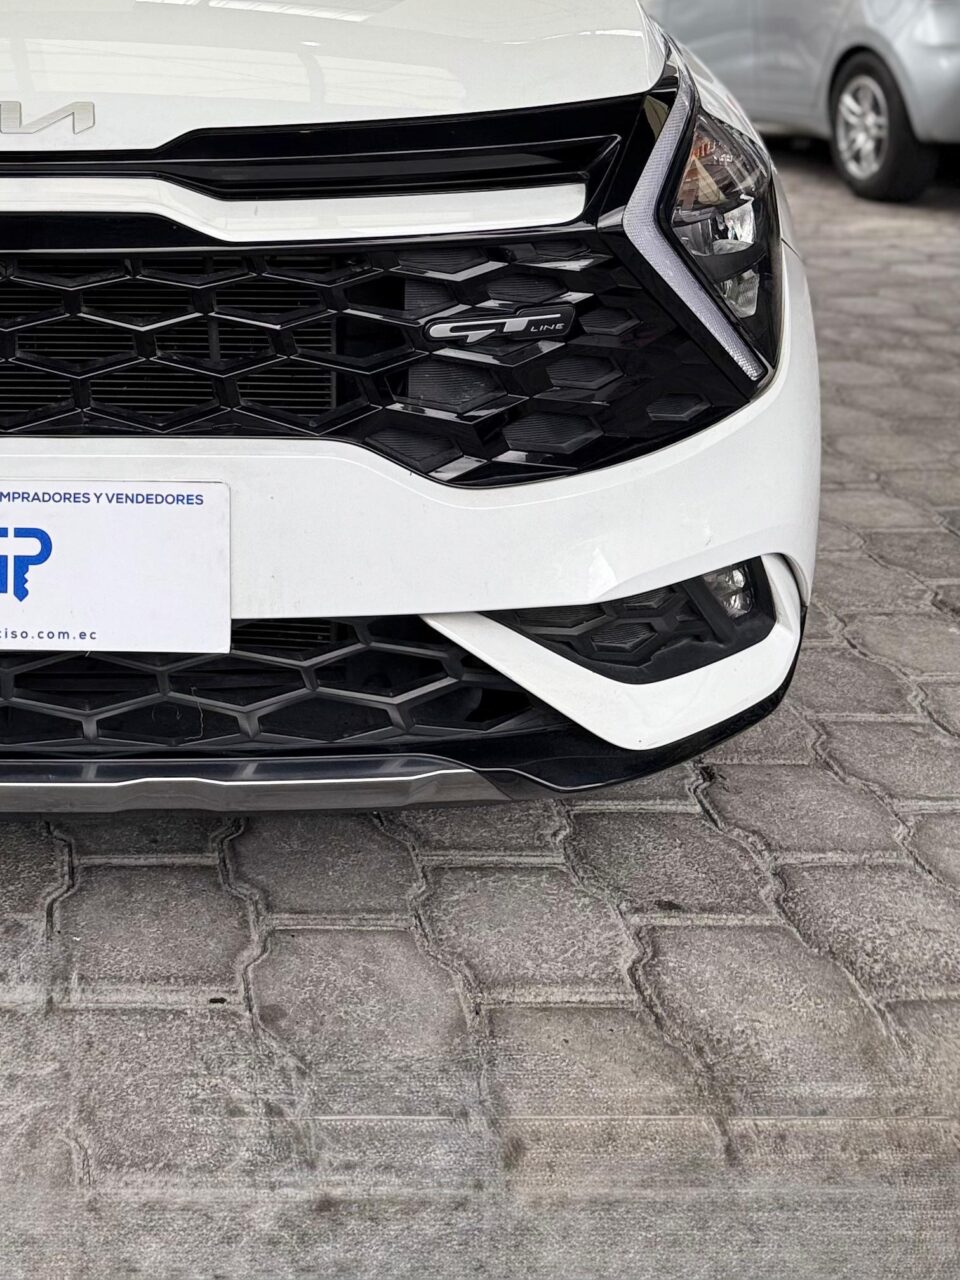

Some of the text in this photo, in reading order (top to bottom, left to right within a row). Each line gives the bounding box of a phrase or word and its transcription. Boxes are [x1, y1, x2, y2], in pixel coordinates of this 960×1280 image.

[530, 322, 565, 332] LINE
[93, 492, 104, 504] Y
[105, 493, 204, 506] VENDEDORES
